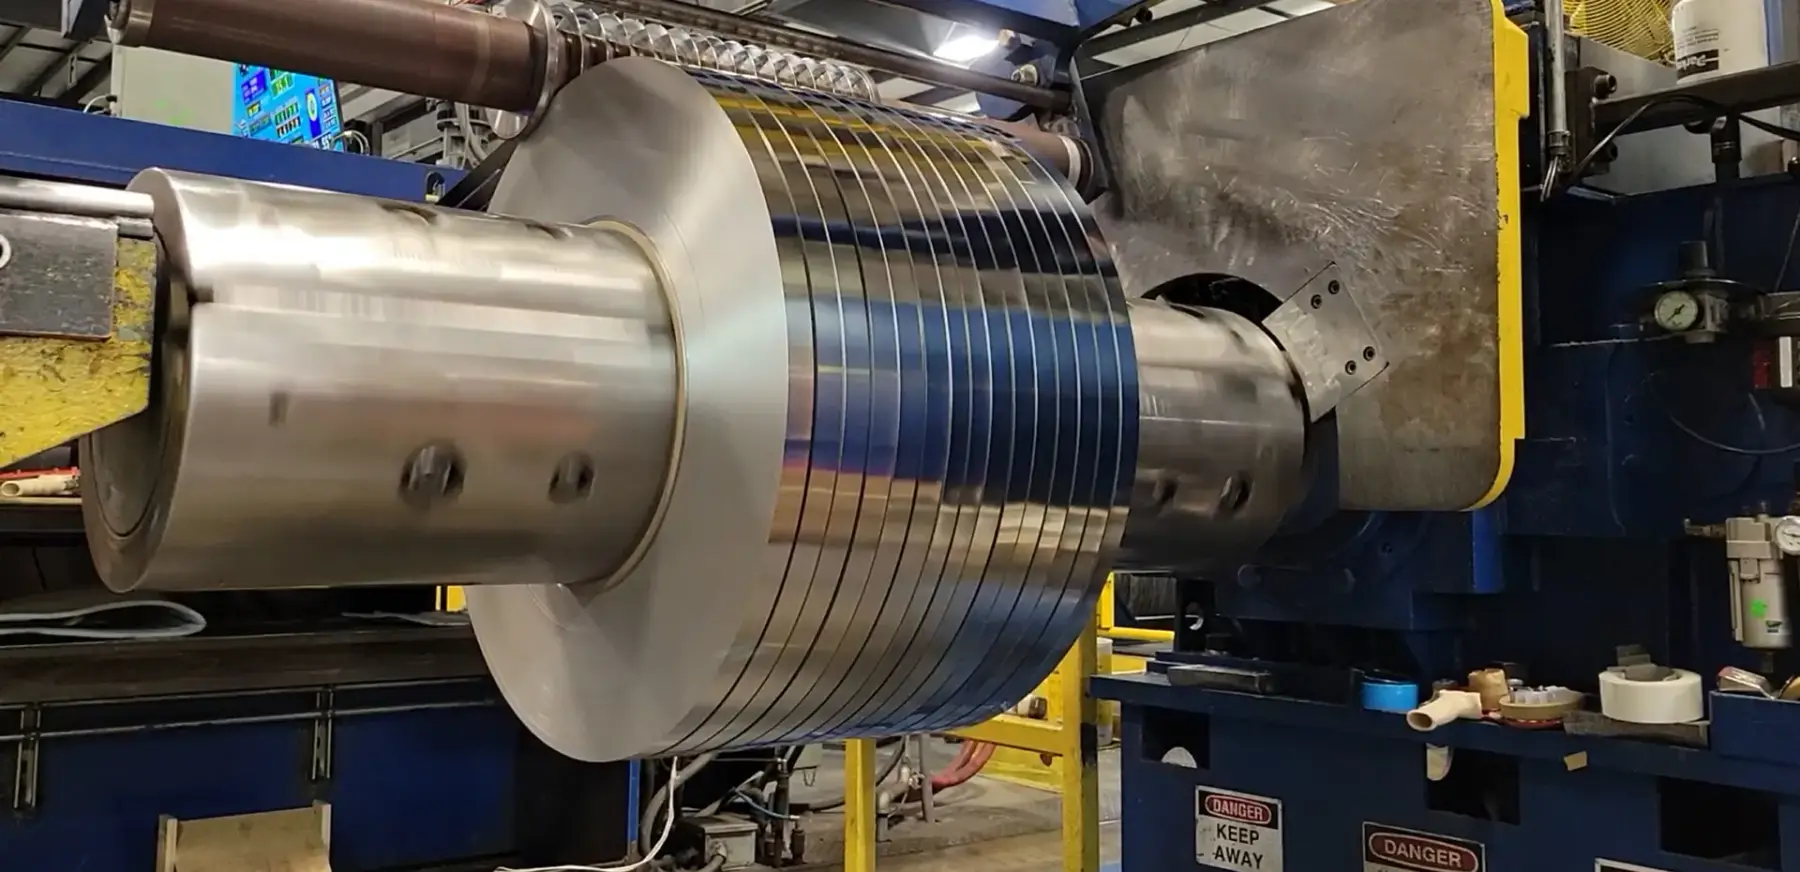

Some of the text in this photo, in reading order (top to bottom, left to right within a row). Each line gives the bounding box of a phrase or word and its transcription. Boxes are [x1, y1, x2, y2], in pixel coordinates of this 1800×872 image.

[1212, 798, 1264, 820] DANGER
[1216, 823, 1260, 845] KEEP
[1214, 844, 1264, 870] AWAY
[1383, 839, 1463, 868] DANGER
